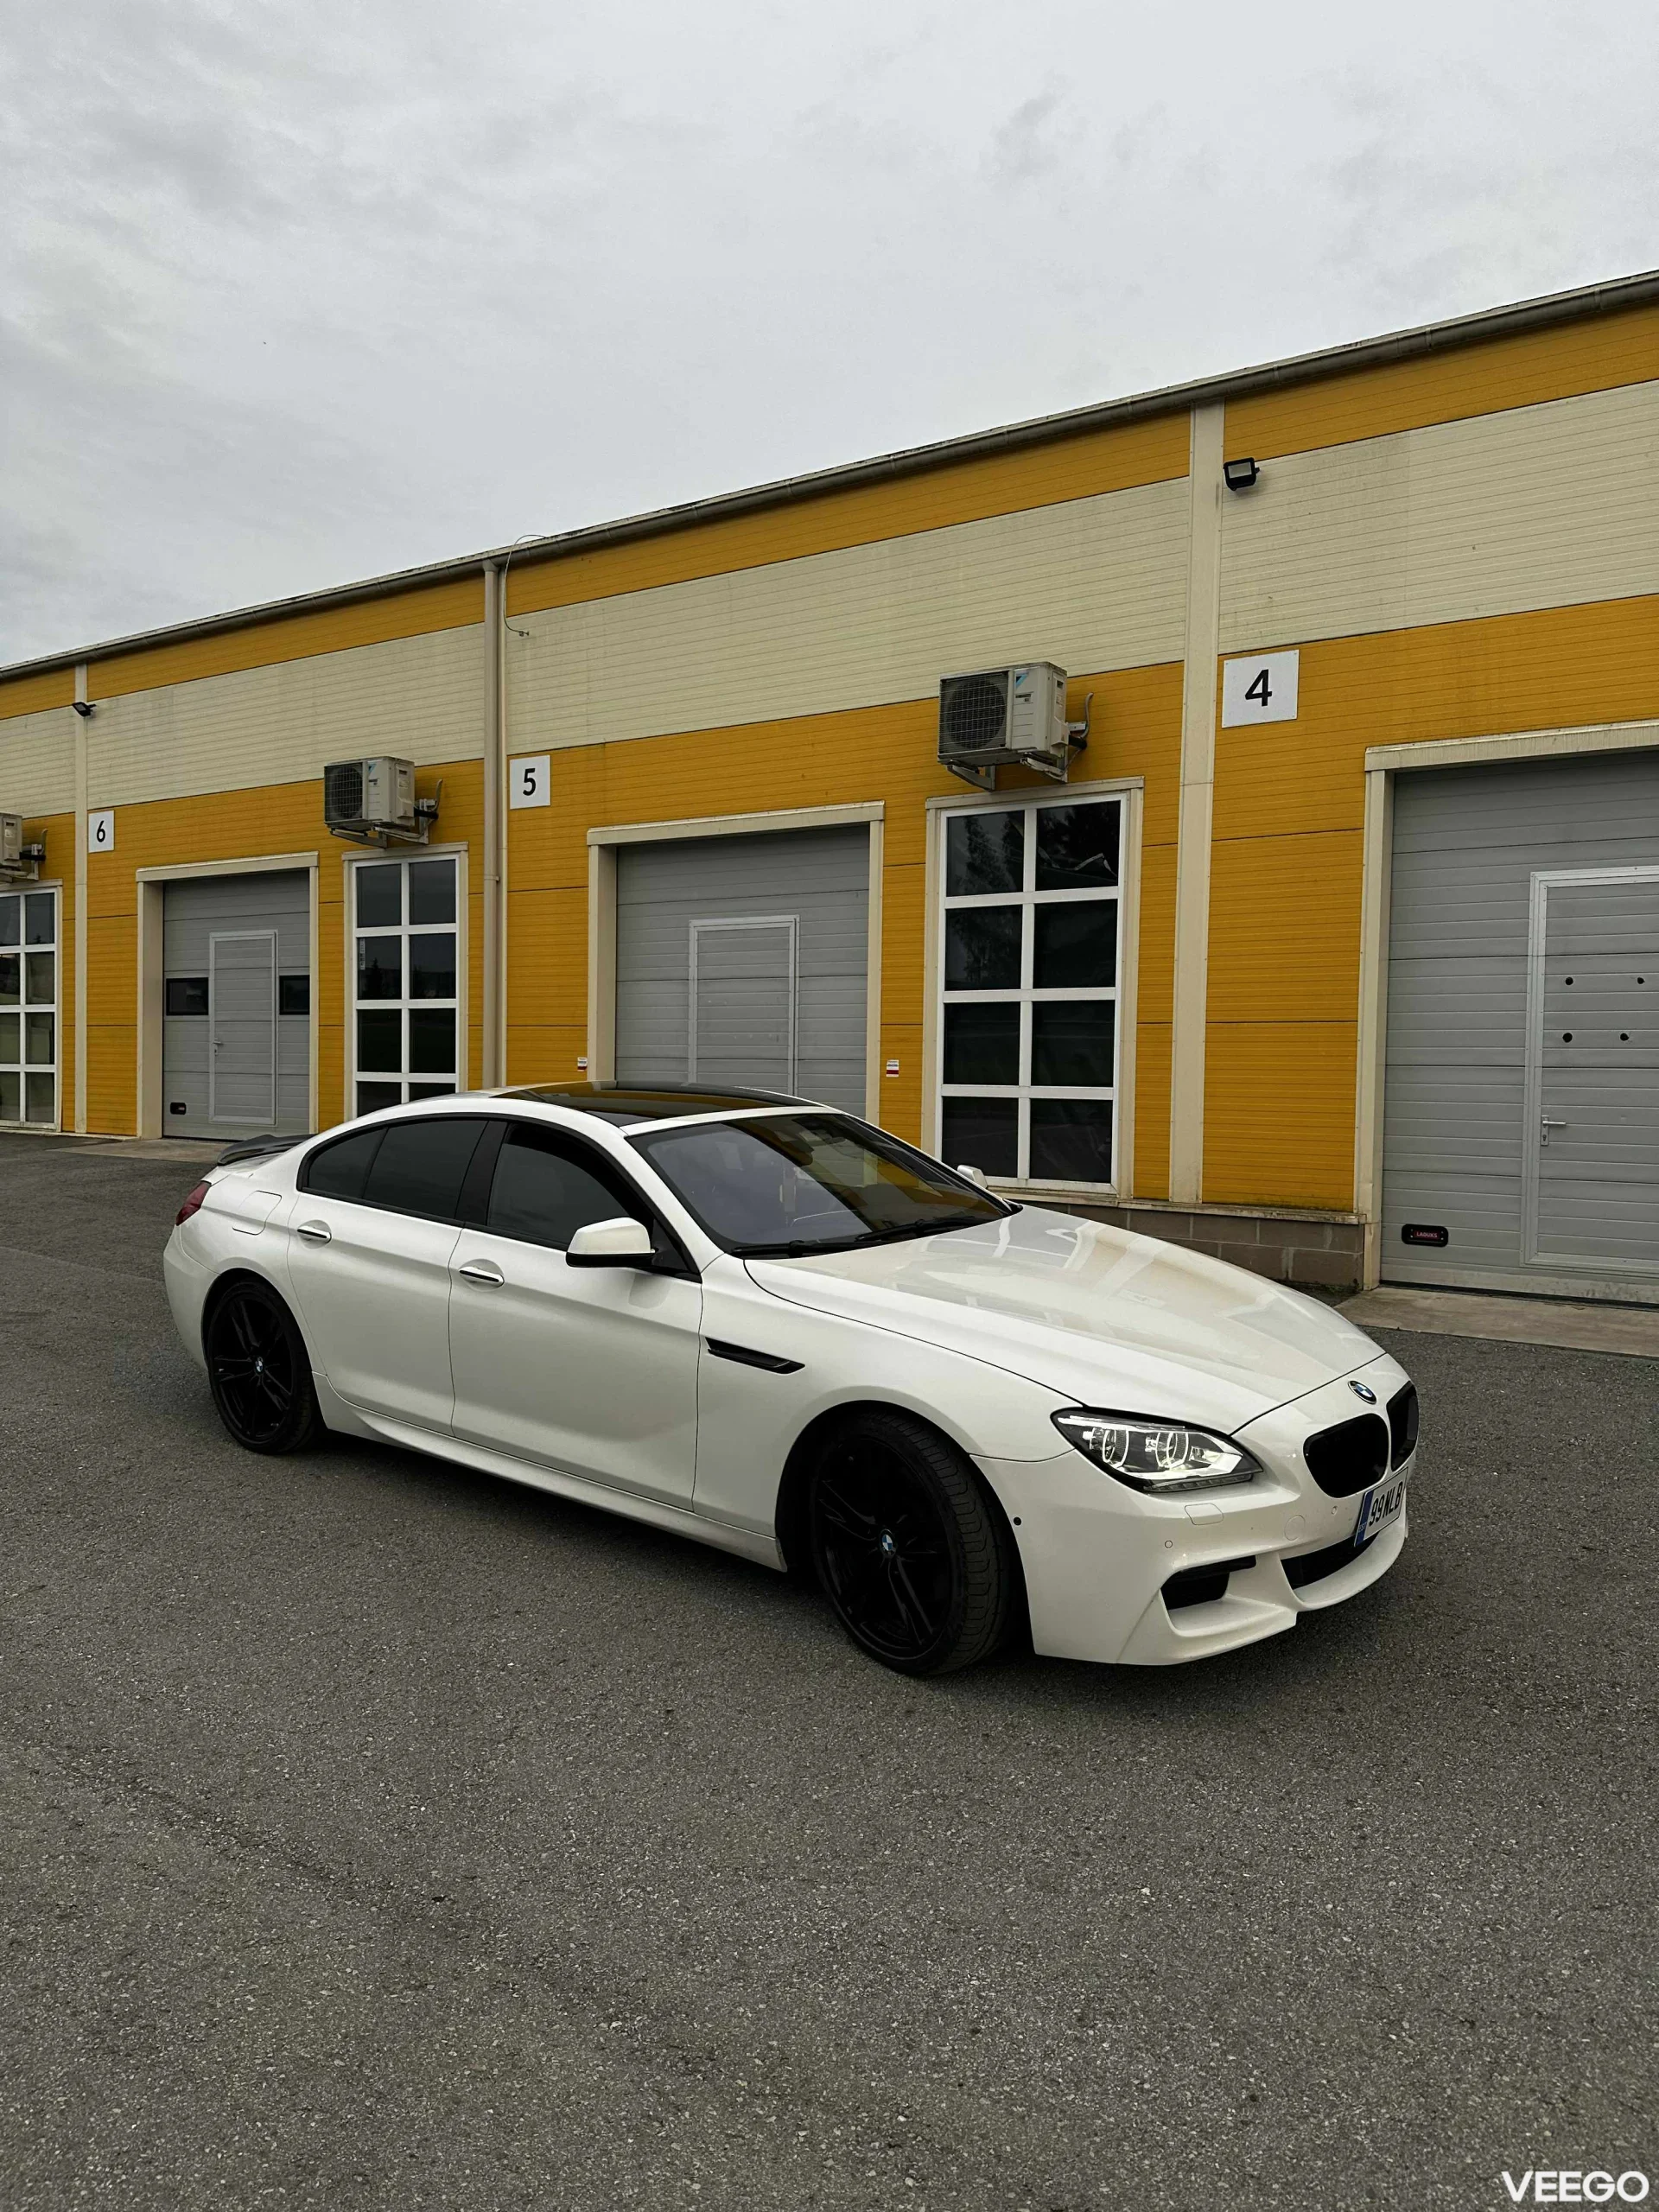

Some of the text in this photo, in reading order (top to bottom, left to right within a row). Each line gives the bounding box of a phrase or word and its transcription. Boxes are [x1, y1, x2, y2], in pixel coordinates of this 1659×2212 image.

[1245, 669, 1273, 707] 4
[523, 767, 537, 796] 5
[96, 820, 106, 842] 6
